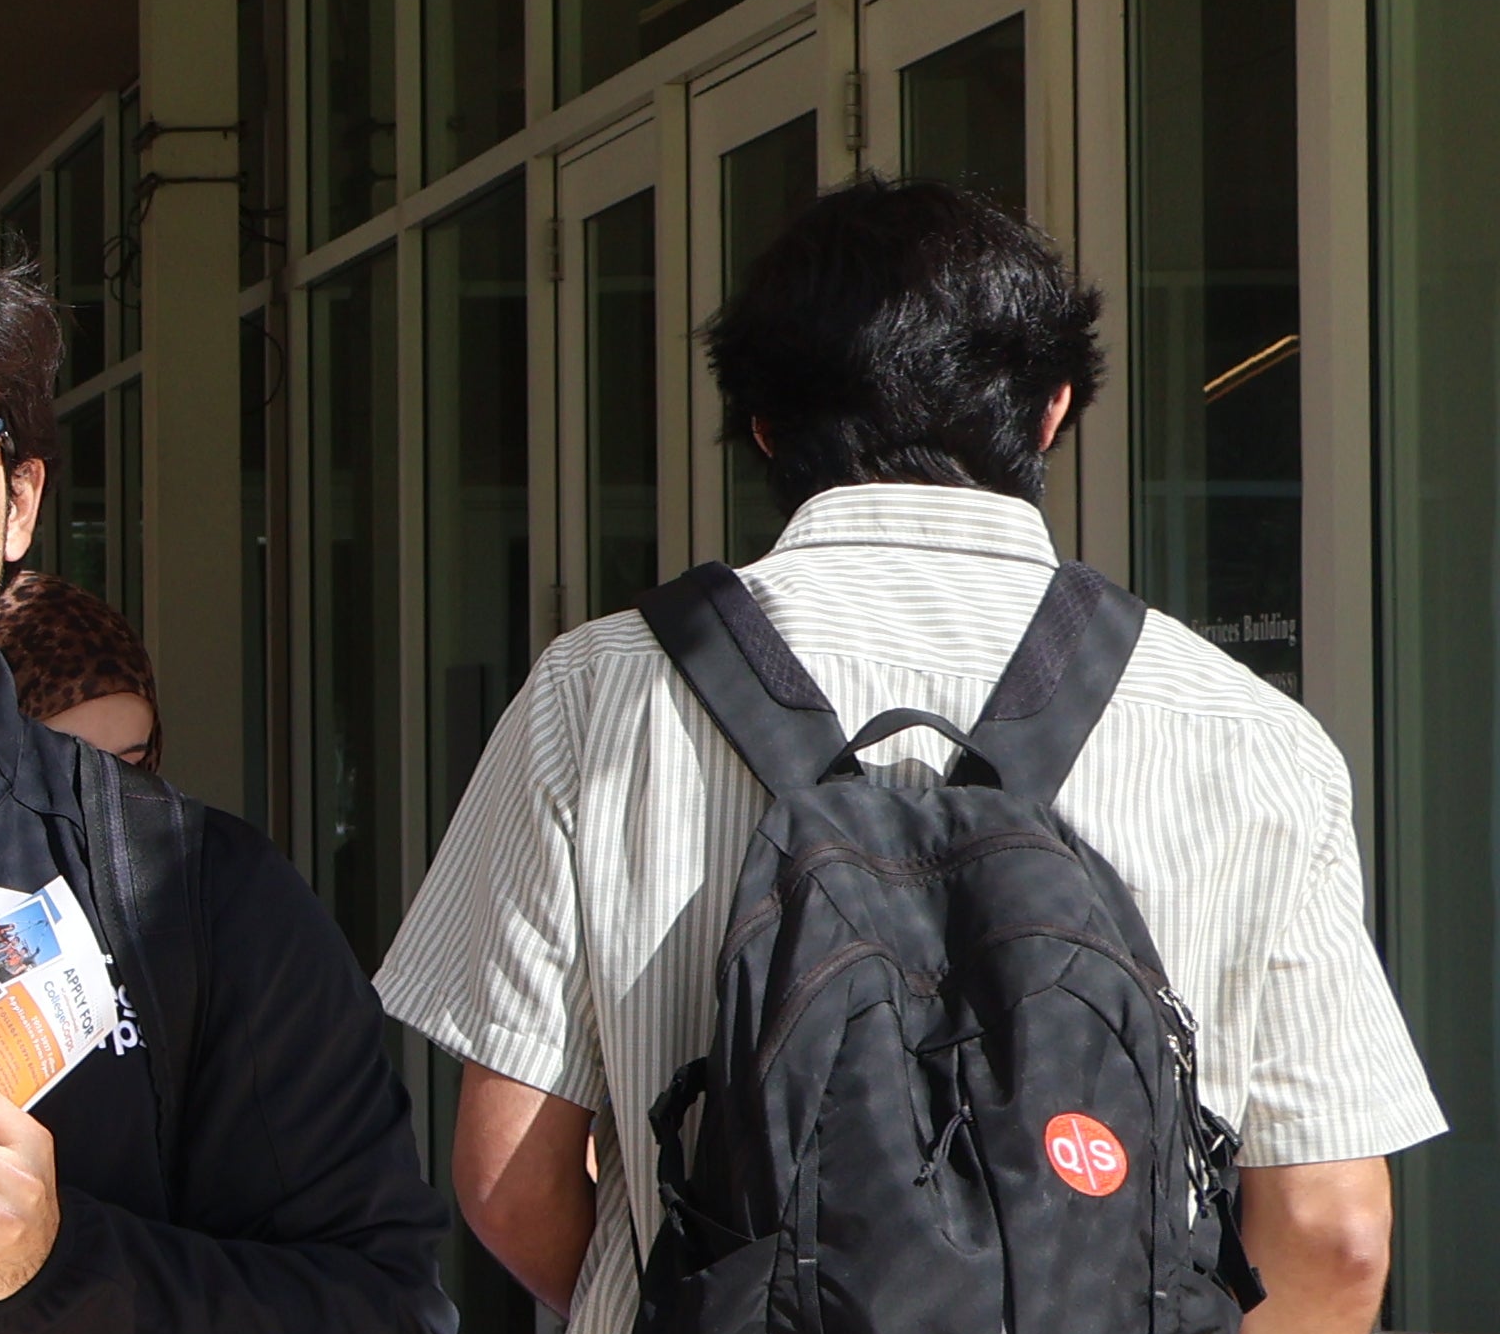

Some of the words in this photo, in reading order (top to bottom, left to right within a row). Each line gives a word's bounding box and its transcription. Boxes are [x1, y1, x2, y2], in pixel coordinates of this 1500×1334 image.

[1243, 612, 1297, 647] Building
[62, 967, 87, 1007] APPLY
[78, 1008, 96, 1039] FOR
